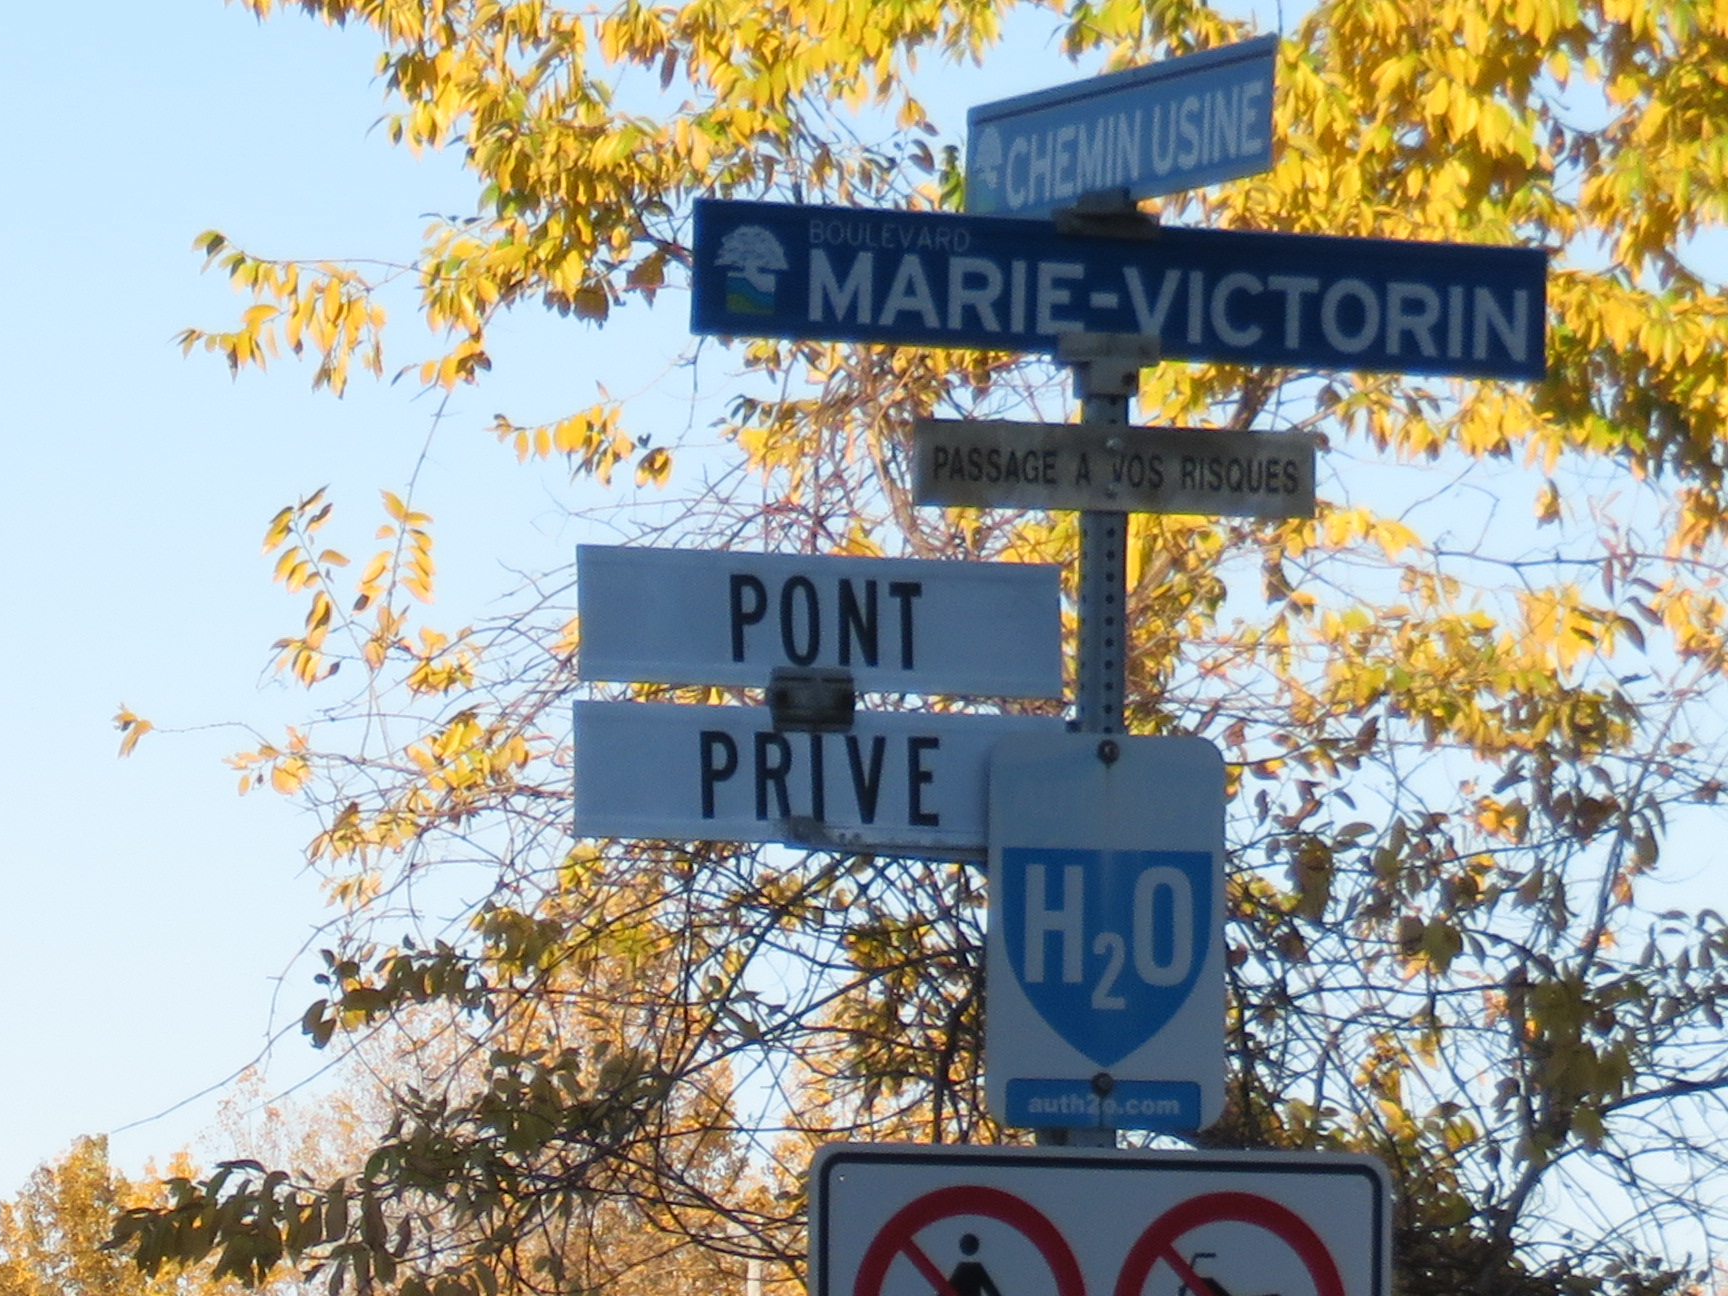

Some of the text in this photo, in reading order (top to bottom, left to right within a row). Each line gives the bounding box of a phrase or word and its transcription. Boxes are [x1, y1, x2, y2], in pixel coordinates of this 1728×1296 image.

[1005, 80, 1265, 210] CHEMIN USINE
[809, 219, 971, 253] BOULEVARD
[807, 247, 1532, 363] MARIE-VICTORIN
[933, 447, 1058, 485] PASSAGE
[1112, 454, 1165, 489] VOS
[1180, 455, 1300, 495] RISQUES
[729, 573, 924, 672] PONT
[700, 729, 942, 828] PRIVE
[1023, 863, 1194, 1011] H2O
